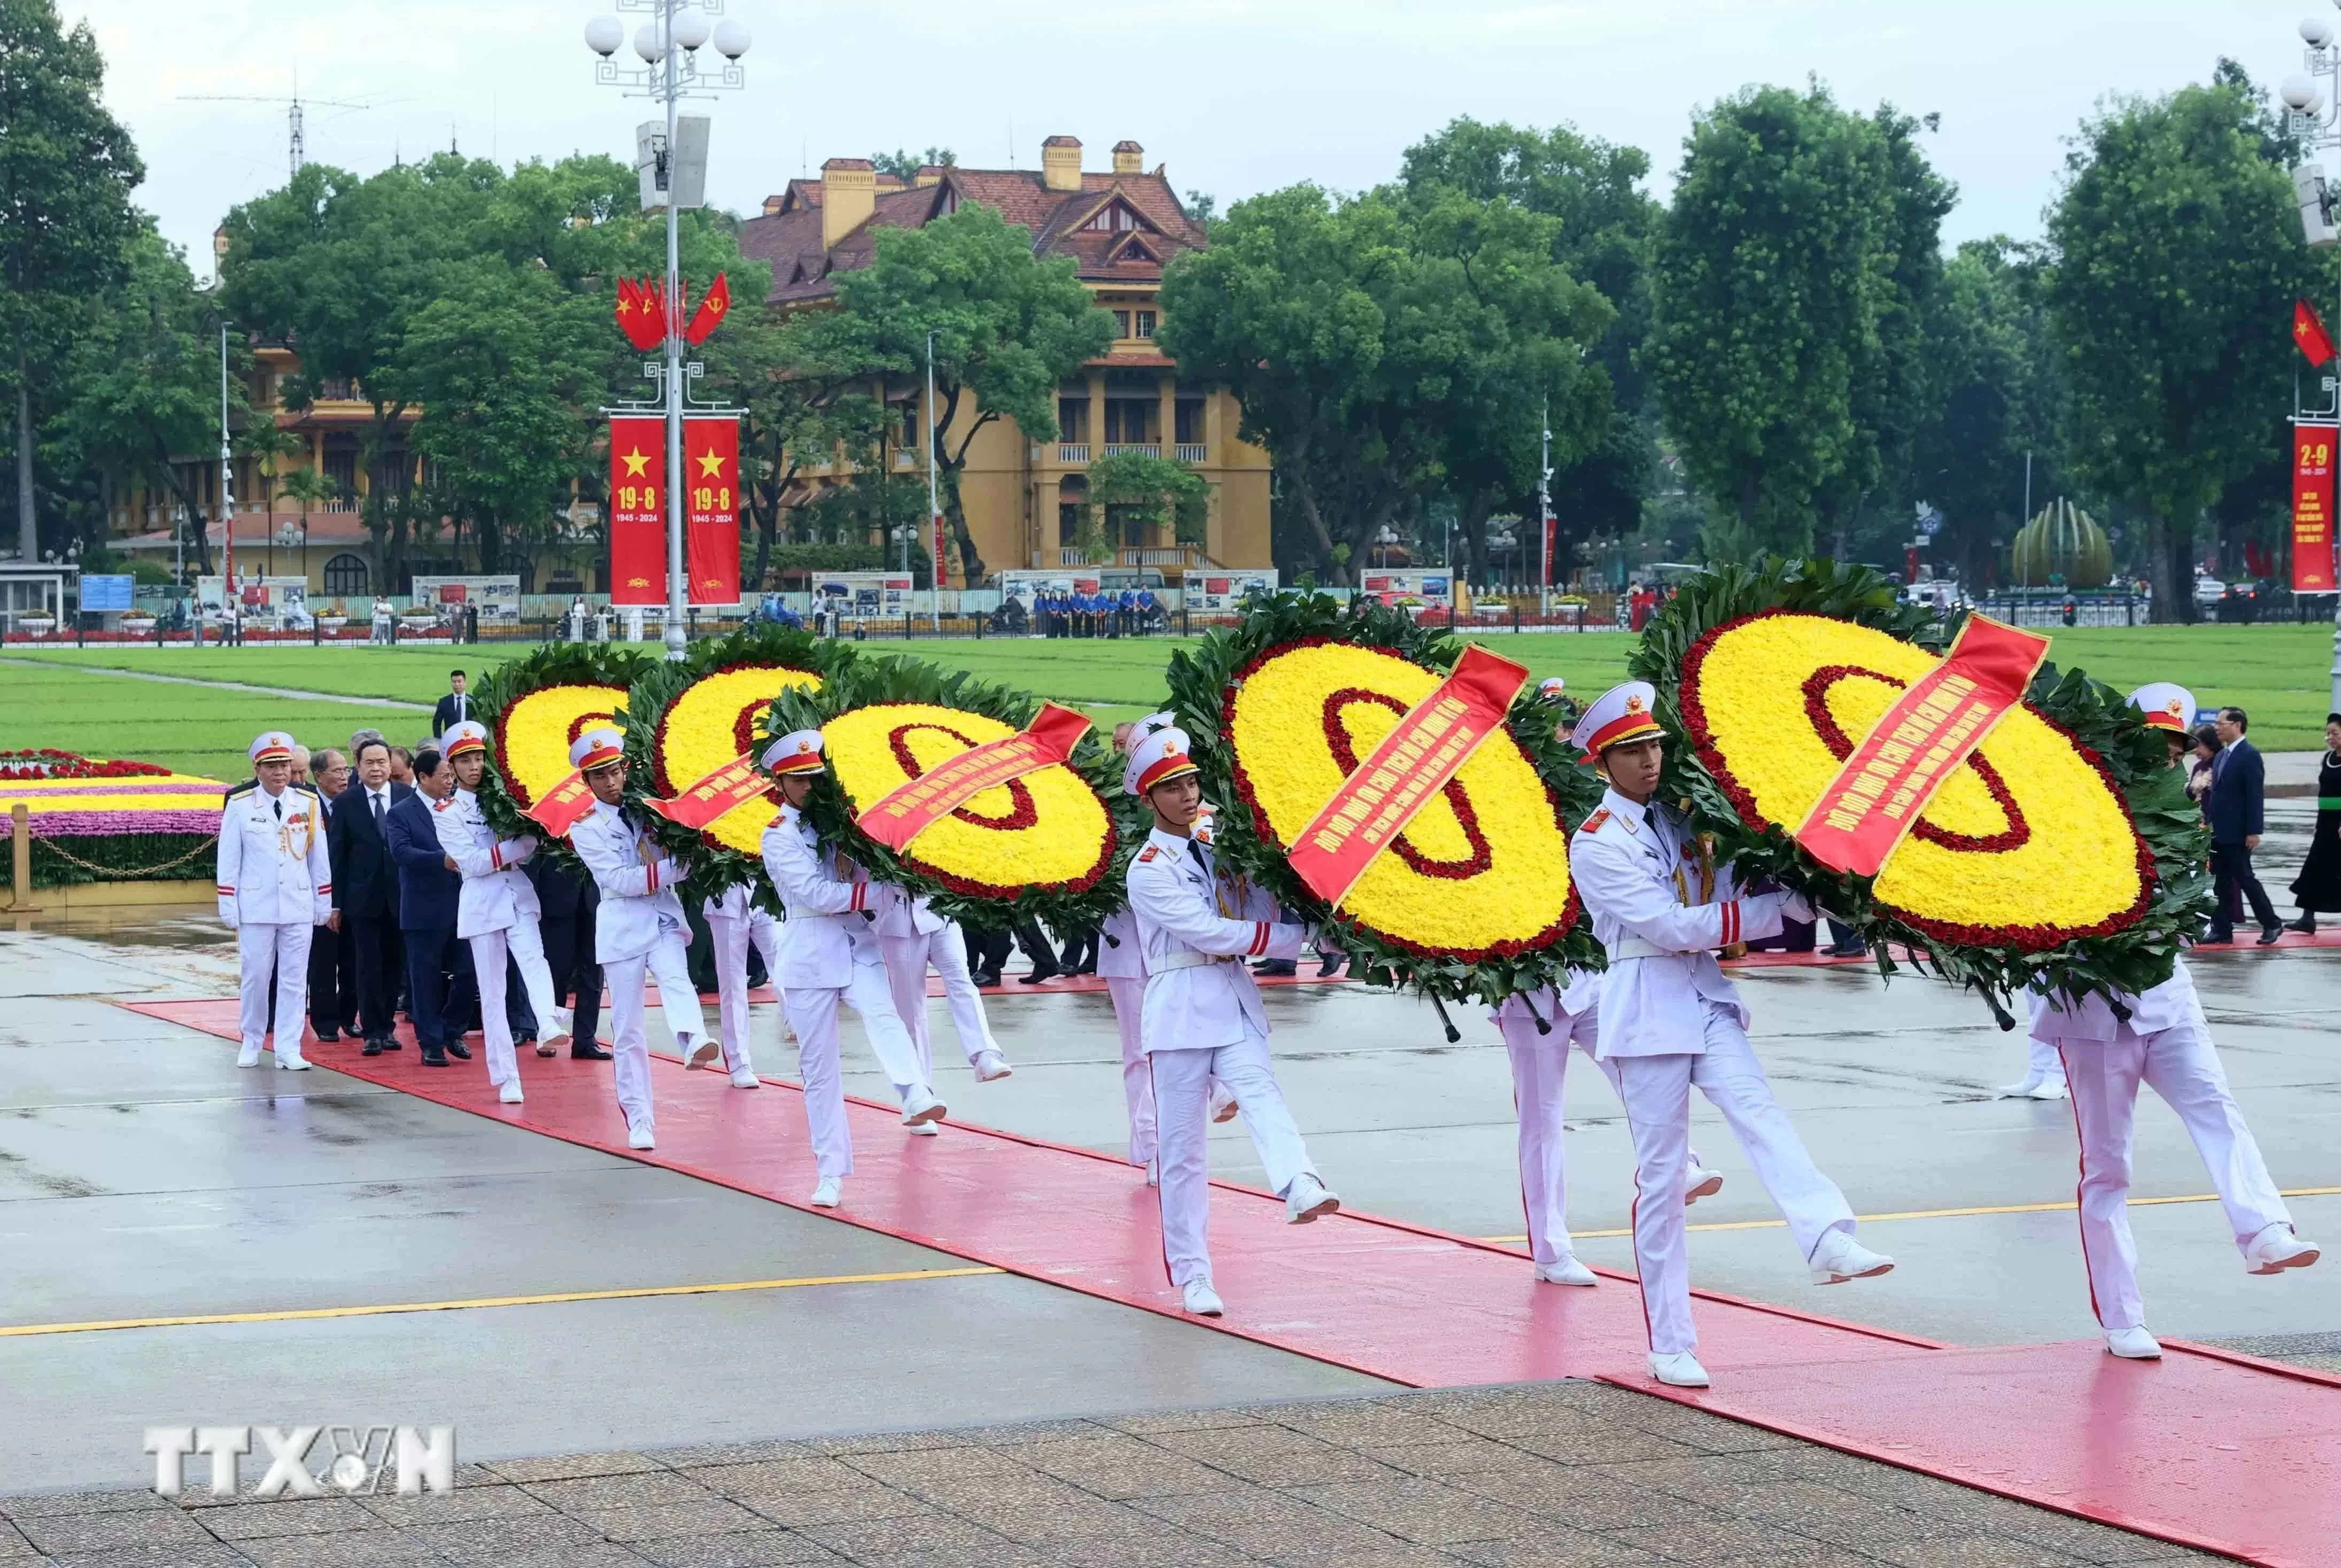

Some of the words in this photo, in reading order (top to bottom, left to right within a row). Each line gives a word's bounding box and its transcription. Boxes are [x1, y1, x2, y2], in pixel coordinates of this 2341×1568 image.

[2300, 444, 2328, 466] 2-9
[618, 486, 655, 510] 19-8
[693, 487, 730, 511] 19-8
[616, 514, 633, 522] 1945
[639, 514, 658, 522] 2024
[692, 515, 710, 523] 1945
[715, 514, 733, 523] 2024
